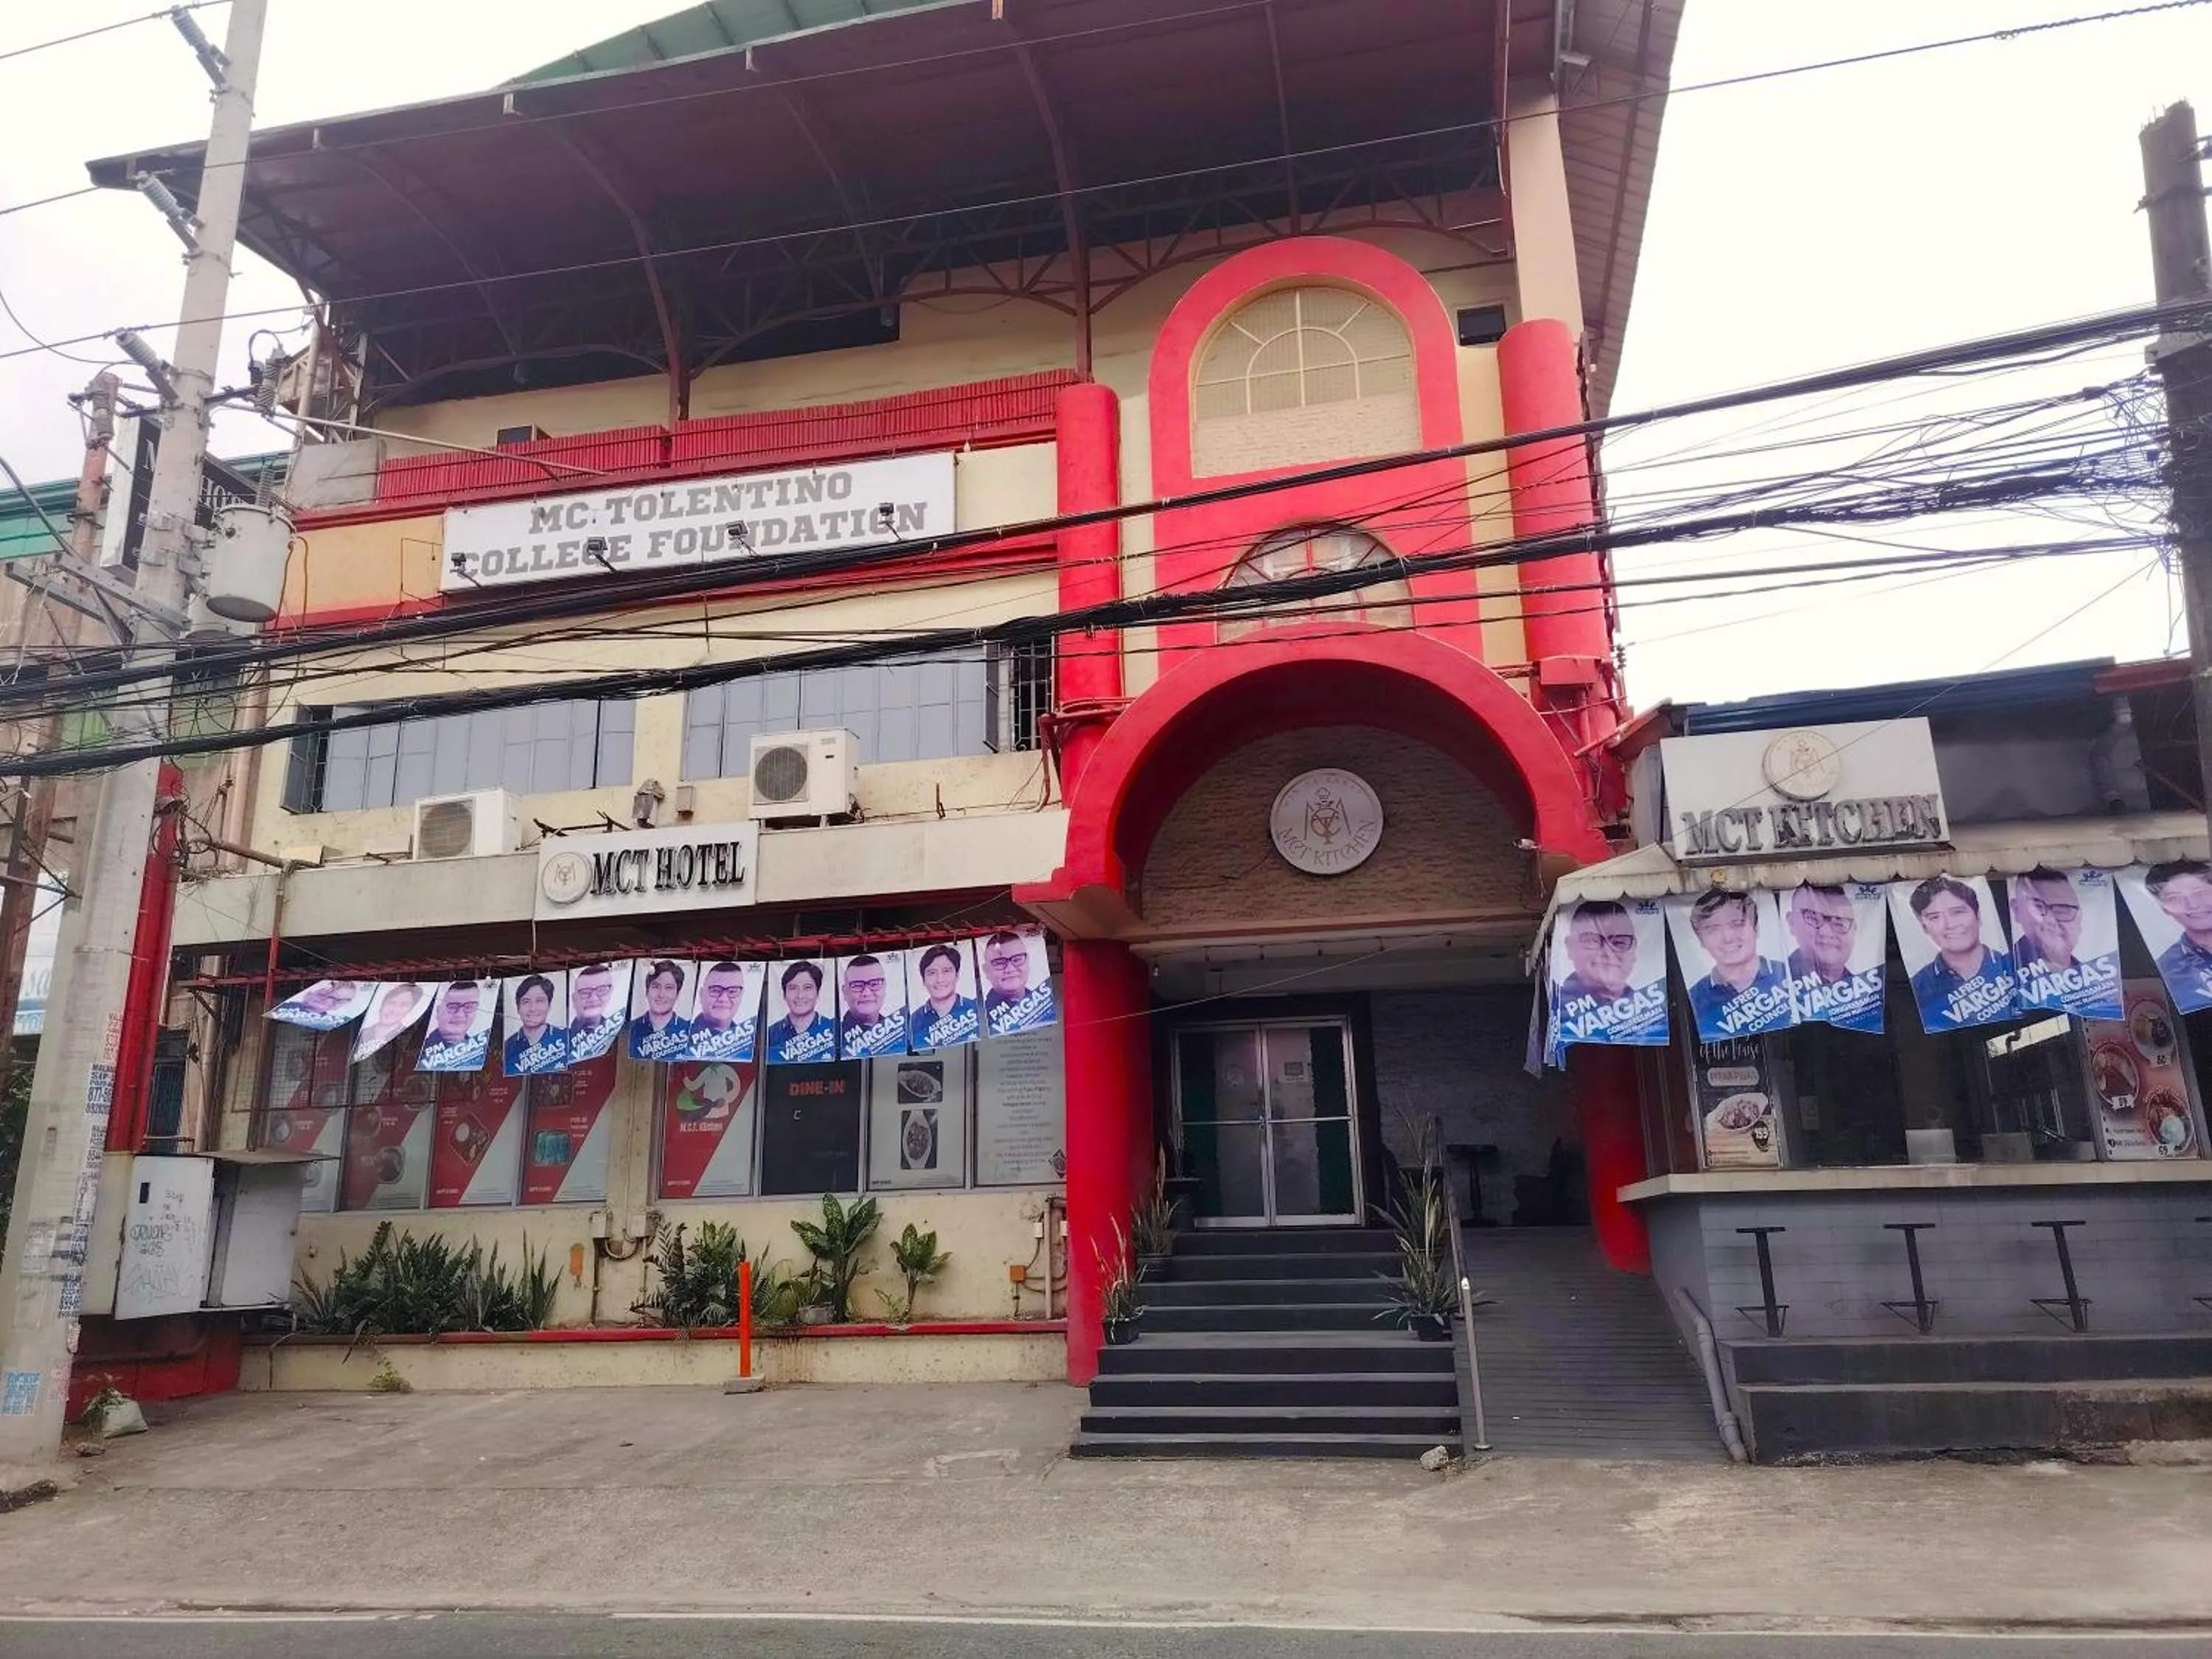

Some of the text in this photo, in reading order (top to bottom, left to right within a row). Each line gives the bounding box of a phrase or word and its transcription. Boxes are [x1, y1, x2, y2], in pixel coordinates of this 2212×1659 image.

[605, 472, 853, 526] TOLENTINO
[1681, 794, 1942, 855] MCT KITCHEN
[590, 841, 745, 895] MCT HOTEL
[1793, 970, 1823, 995] PM
[2017, 958, 2051, 985] PM
[2018, 956, 2118, 1006] VARGAS
[1565, 993, 1598, 1017] PM
[1722, 987, 1759, 1016] ALFRED
[1795, 968, 1882, 1021] VARGAS
[1947, 975, 1986, 1004] ALFRED
[989, 1001, 1011, 1020] PM
[991, 981, 1051, 1034] VARGAS
[1565, 982, 1666, 1039] VARGAS
[571, 1009, 625, 1060] VARGAS
[571, 1029, 588, 1047] PM
[637, 1029, 690, 1057] VARGAS
[689, 1019, 755, 1060] VARGAS
[691, 1026, 713, 1045] PM
[844, 1024, 864, 1044] PM
[844, 1011, 905, 1057] VARGAS
[925, 1008, 978, 1046] VARGAS
[421, 1034, 488, 1070] VARGAS
[425, 1042, 446, 1056] PM
[515, 1038, 566, 1072] VARGAS
[779, 1029, 834, 1062] VARGAS
[789, 1079, 846, 1096] DINE-IN
